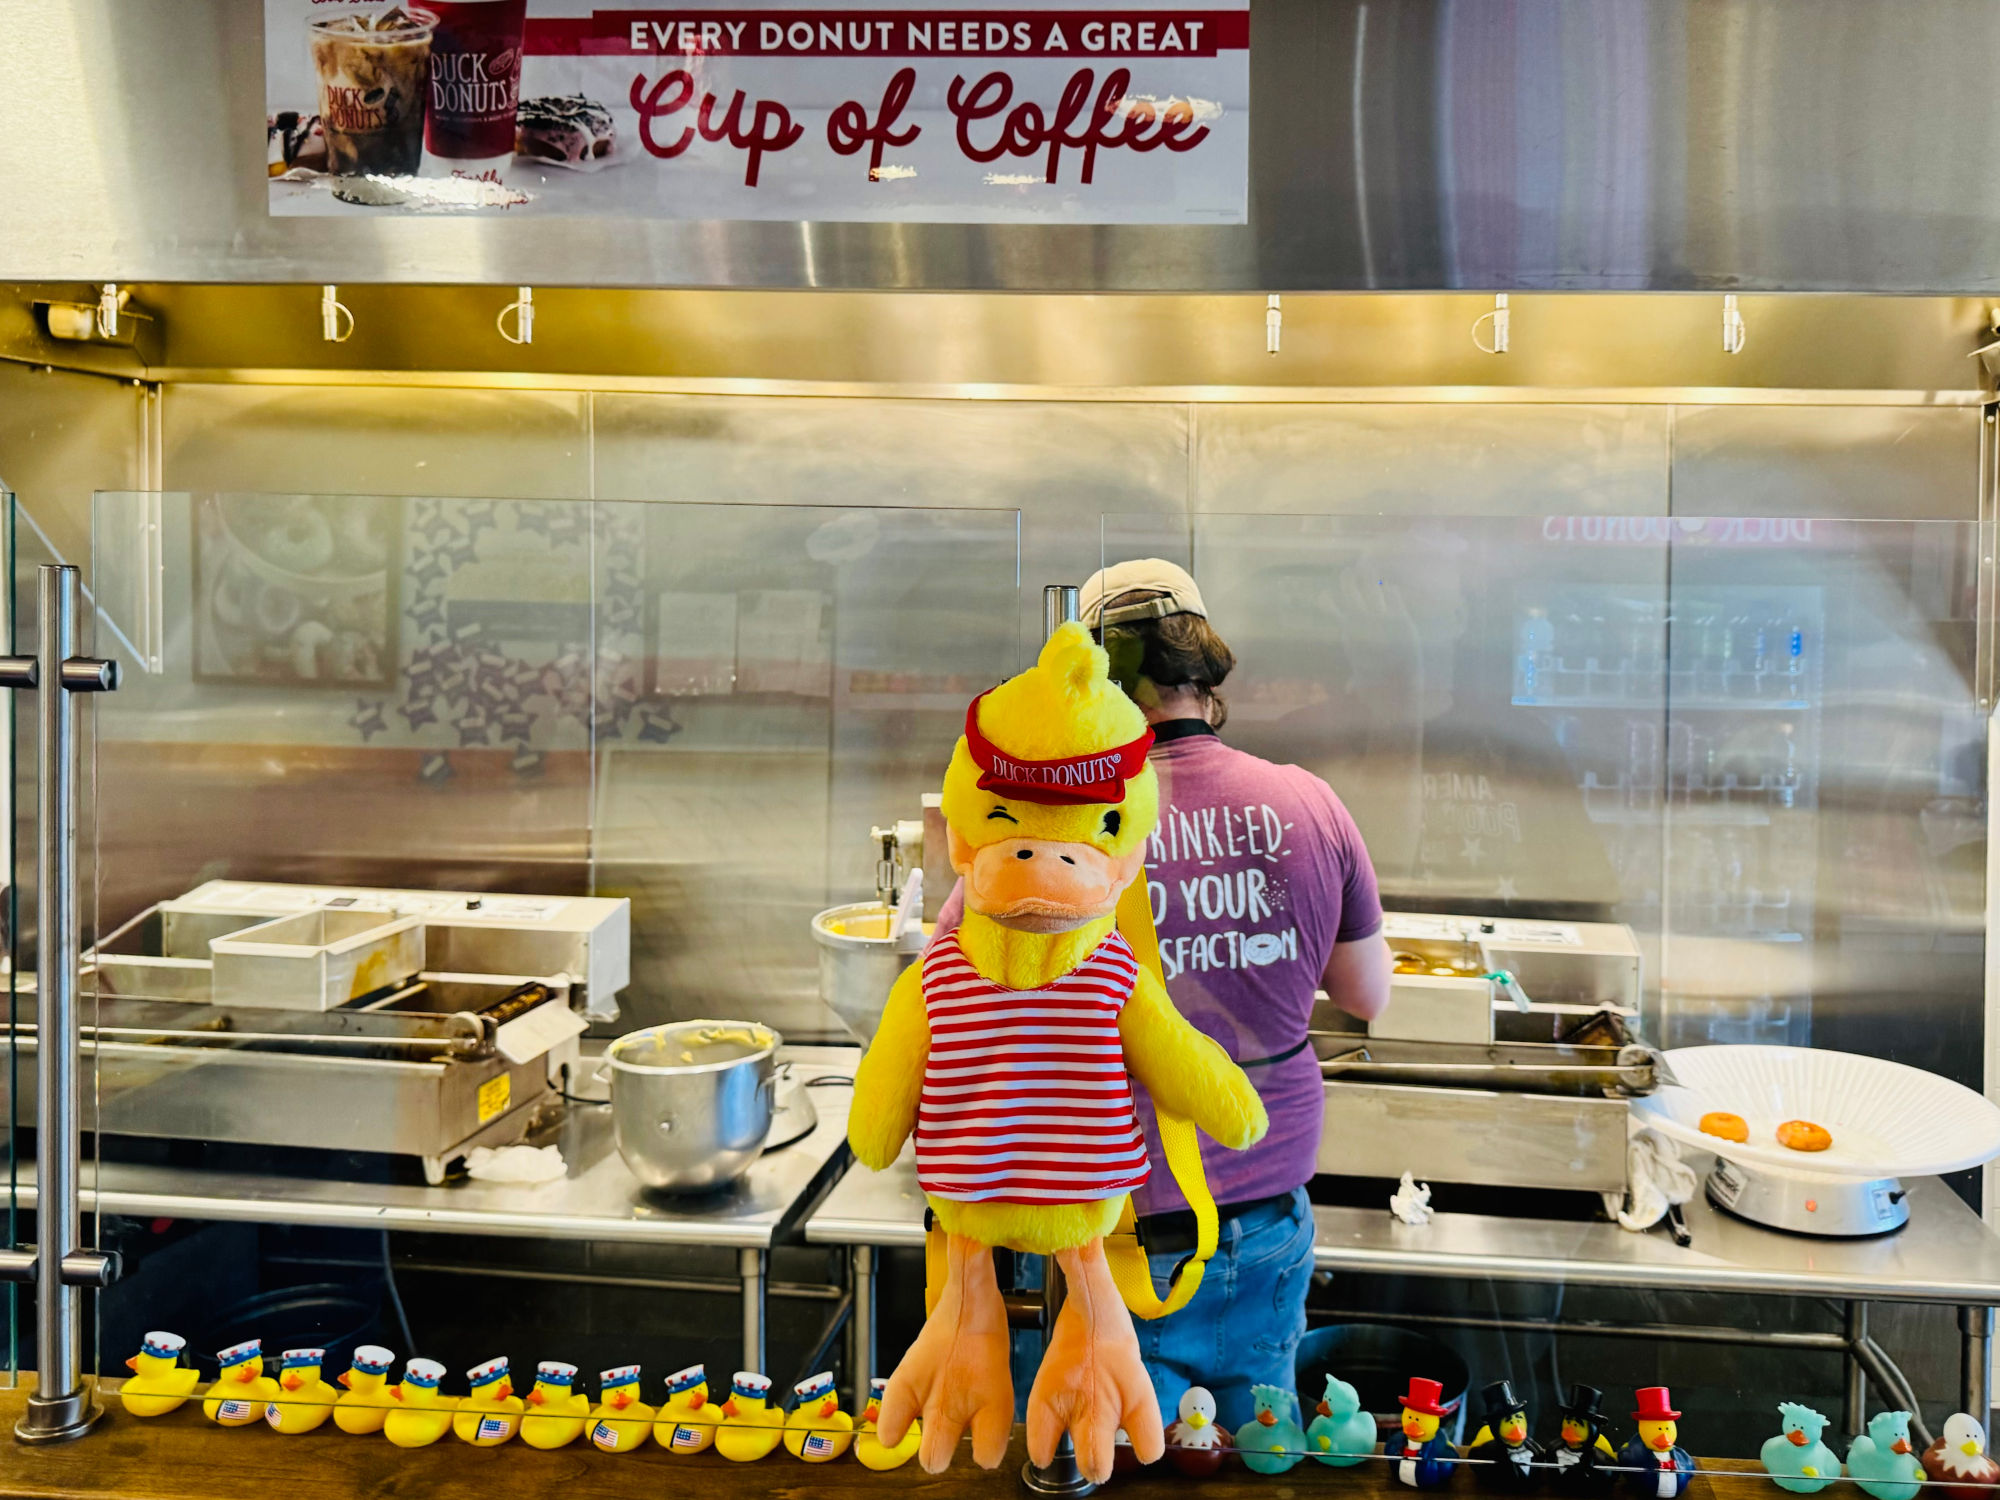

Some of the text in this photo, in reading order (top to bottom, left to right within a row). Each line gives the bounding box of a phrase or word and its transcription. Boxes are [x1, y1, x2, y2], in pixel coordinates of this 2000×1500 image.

[630, 21, 1204, 51] EVERY DONUT NEEDS A GREAT
[430, 53, 489, 83] DUCK
[327, 85, 364, 109] DUCK
[432, 80, 508, 113] DONUTS
[328, 105, 384, 130] DONUTS
[629, 67, 1211, 187] Cup of Coffee
[993, 755, 1038, 784] DUCK
[1150, 804, 1282, 863] RINKLED
[1147, 868, 1272, 926] O YOUR
